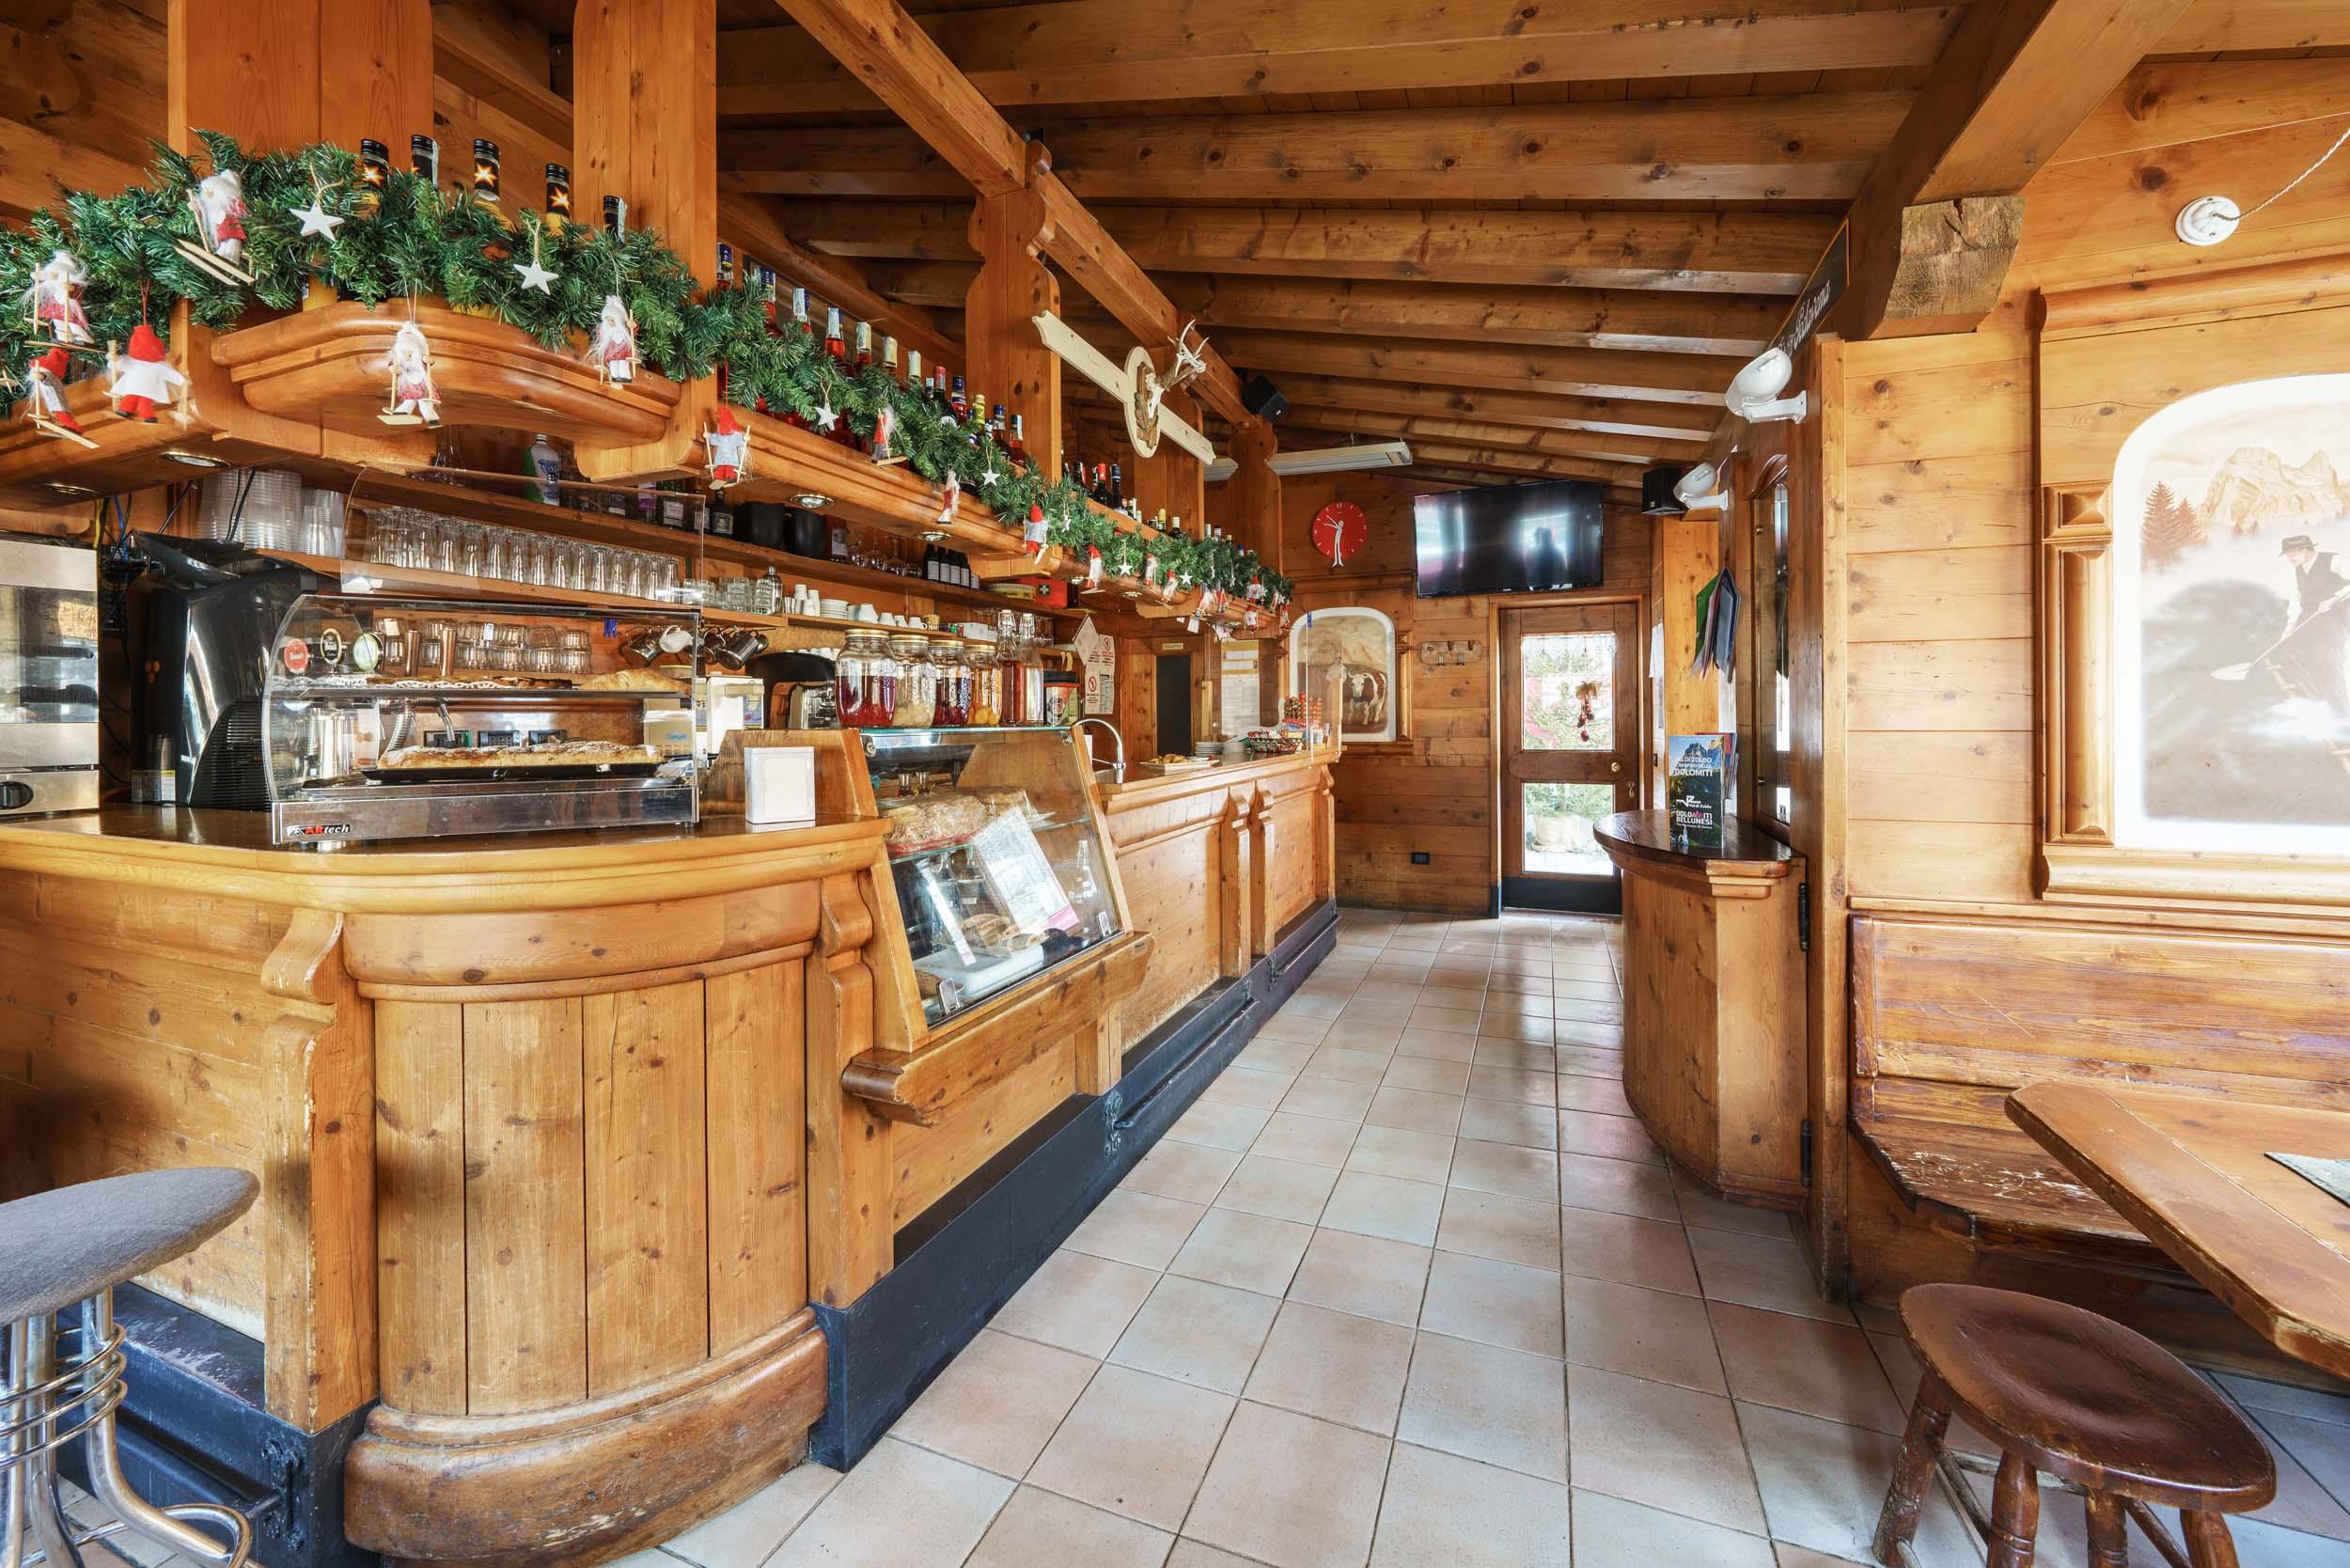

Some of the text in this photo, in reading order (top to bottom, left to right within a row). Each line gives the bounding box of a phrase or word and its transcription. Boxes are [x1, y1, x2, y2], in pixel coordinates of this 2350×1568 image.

[1675, 769, 1713, 777] DOLOMITI
[1676, 810, 1713, 819] DOLOMITI
[1676, 817, 1713, 825] BELLUNESI
